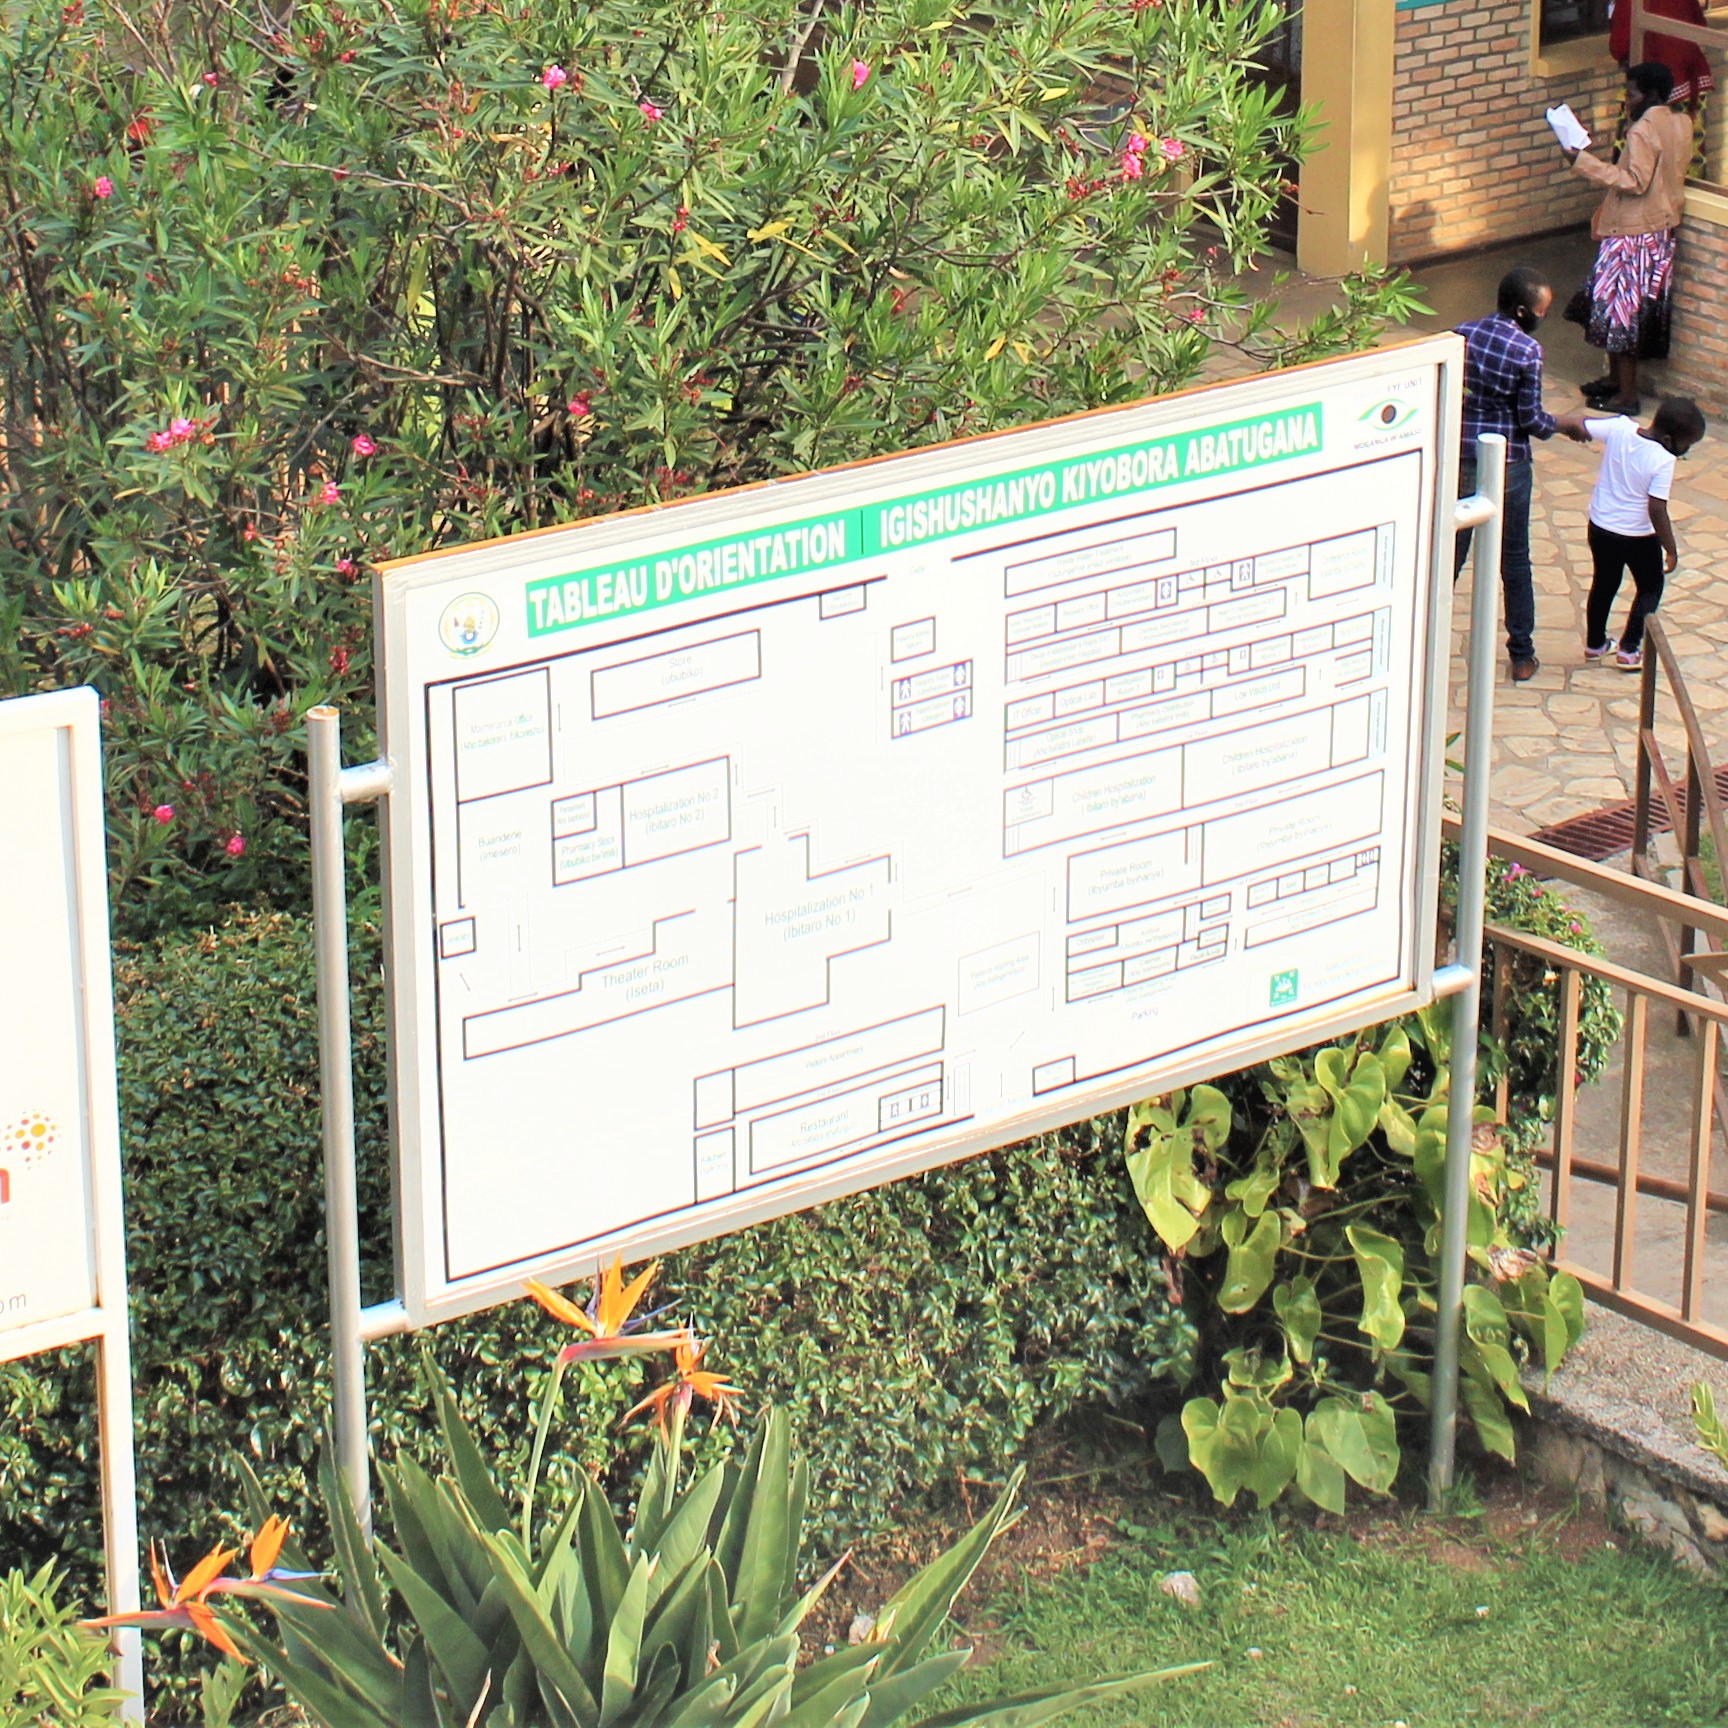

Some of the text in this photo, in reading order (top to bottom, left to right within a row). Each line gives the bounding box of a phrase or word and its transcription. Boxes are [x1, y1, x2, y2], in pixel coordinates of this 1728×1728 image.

[879, 411, 1318, 548] IGISHUSHANYO KIYOBORA ABATUGANA
[530, 519, 845, 629] TABLEAU D'ORIENTATION
[668, 653, 692, 669] Store
[1072, 771, 1156, 805] Children Hospitalization
[629, 787, 719, 824] Hospitalization No 2
[645, 807, 705, 835] (Ibitaro No 2)
[1129, 856, 1152, 873] Room
[764, 882, 874, 929] Hospitalization No 1
[783, 907, 856, 942] (Ibitaro No 1)
[601, 951, 689, 990] Theater Room
[625, 976, 664, 1002] (Iseta)
[800, 1108, 848, 1135] Restaurant
